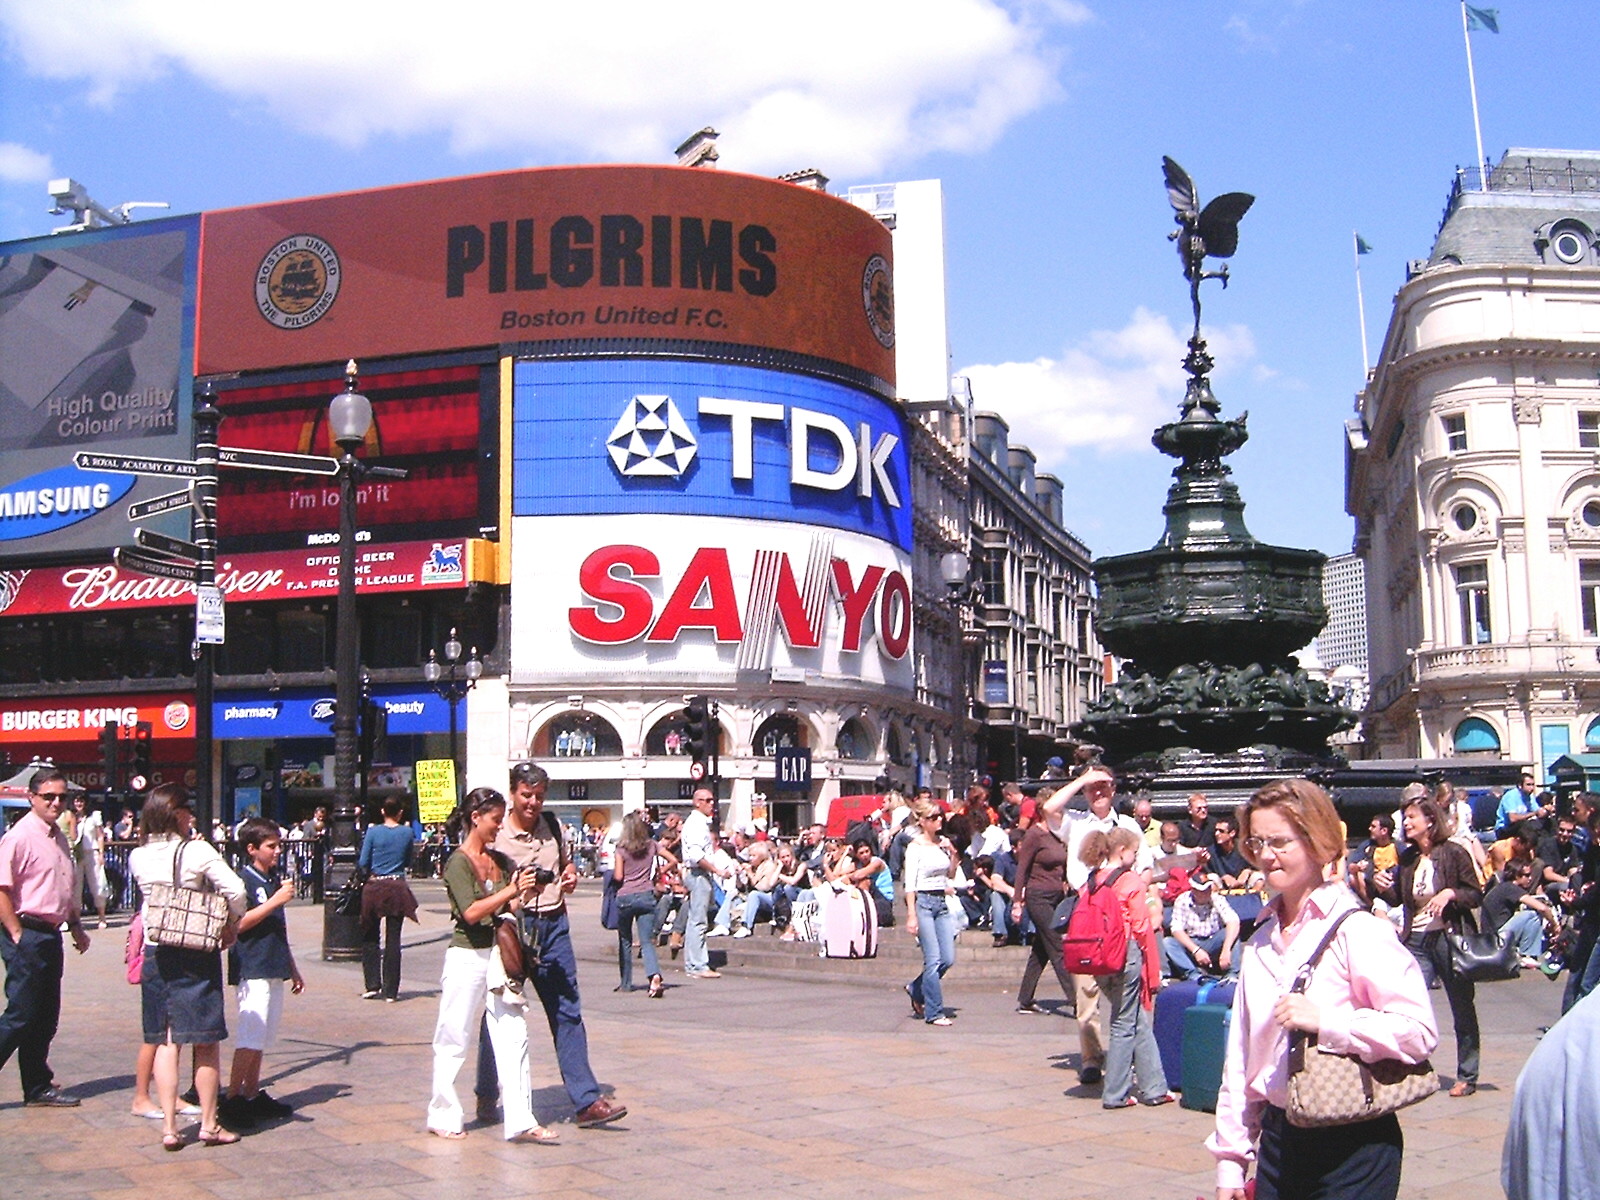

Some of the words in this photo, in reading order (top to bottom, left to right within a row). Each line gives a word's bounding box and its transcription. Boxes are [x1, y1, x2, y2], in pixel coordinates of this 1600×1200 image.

[259, 240, 297, 284] BOSTON
[305, 238, 337, 276] UNITED
[446, 214, 777, 298] PILGRIMS
[261, 298, 279, 320] THE
[284, 291, 333, 326] PILGRIMS
[500, 309, 586, 330] Boston
[594, 305, 679, 326] United
[684, 308, 729, 329] F.C.
[49, 394, 93, 420] High
[101, 387, 175, 411] Quality
[58, 416, 122, 437] Colour
[128, 409, 175, 430] Print
[698, 397, 900, 508] TDK
[92, 457, 119, 468] ROYAL
[122, 460, 163, 472] ACADEMY
[163, 464, 175, 473] OF
[176, 465, 198, 474] ARTS
[0, 483, 110, 517] AMSUNG
[289, 491, 316, 510] i'm
[322, 485, 372, 507] lon'
[376, 484, 390, 503] it
[307, 531, 371, 546] McDod's
[306, 555, 360, 566] OFFIC
[362, 551, 395, 562] BEER
[328, 567, 338, 576] O
[354, 565, 372, 574] HE
[63, 562, 284, 609] Budwiser
[171, 567, 196, 579] CENTR
[286, 580, 308, 590] F.A.
[311, 577, 363, 589] PREMR
[366, 573, 415, 585] LEAGUE
[568, 532, 911, 668] SANYO
[2, 709, 80, 731] BURGER
[84, 706, 138, 728] KING
[224, 706, 278, 720] pharmacy
[385, 700, 425, 715] beauty
[65, 772, 107, 786] URGE
[782, 756, 807, 782] GAP
[570, 783, 586, 797] GAP
[256, 886, 268, 903] 3
